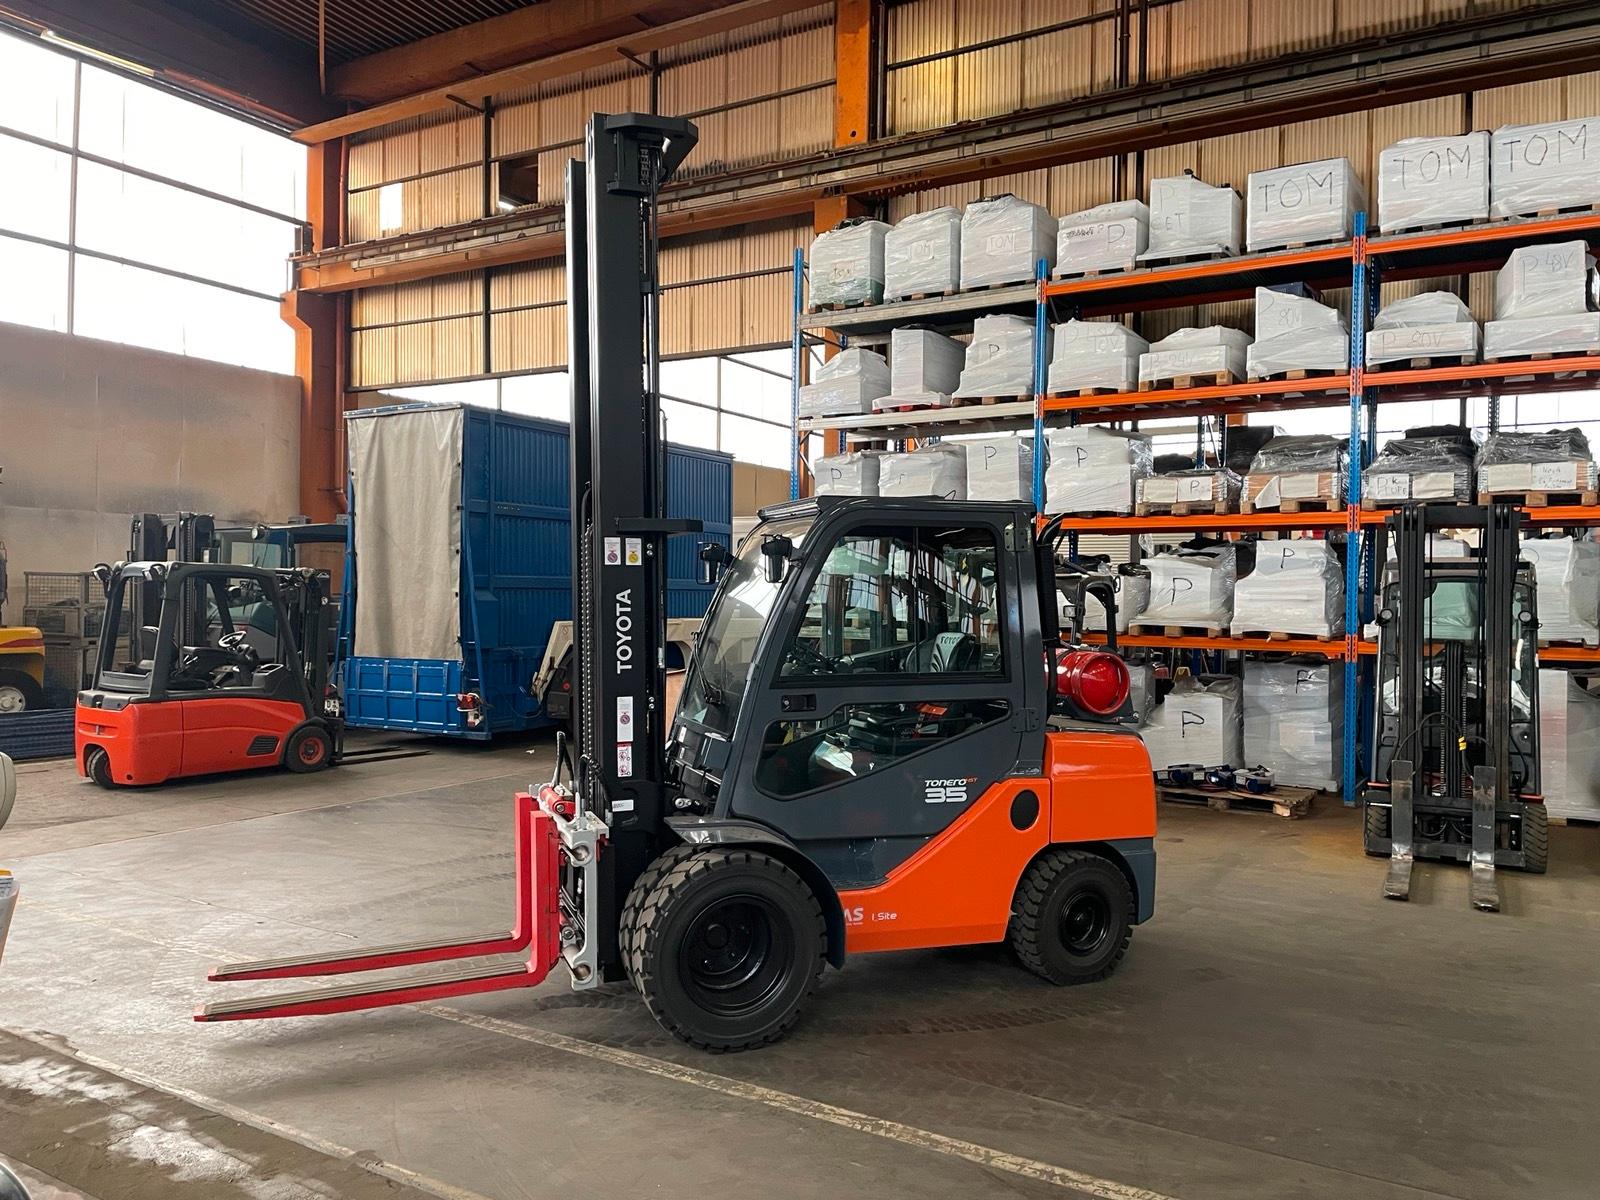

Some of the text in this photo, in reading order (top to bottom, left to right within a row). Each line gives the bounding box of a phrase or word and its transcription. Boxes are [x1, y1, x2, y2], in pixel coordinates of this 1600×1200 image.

[1503, 124, 1587, 172] TOM
[1393, 145, 1471, 190] TOM
[1259, 172, 1334, 212] TOM
[989, 344, 1000, 358] P
[984, 446, 997, 470] P
[1076, 446, 1088, 467] P
[831, 468, 842, 487] P
[1190, 480, 1200, 494] P
[1281, 548, 1295, 568] P
[1171, 578, 1193, 605] P
[616, 588, 633, 674] TOYOTA
[1182, 711, 1205, 738] P
[925, 786, 967, 804] 35
